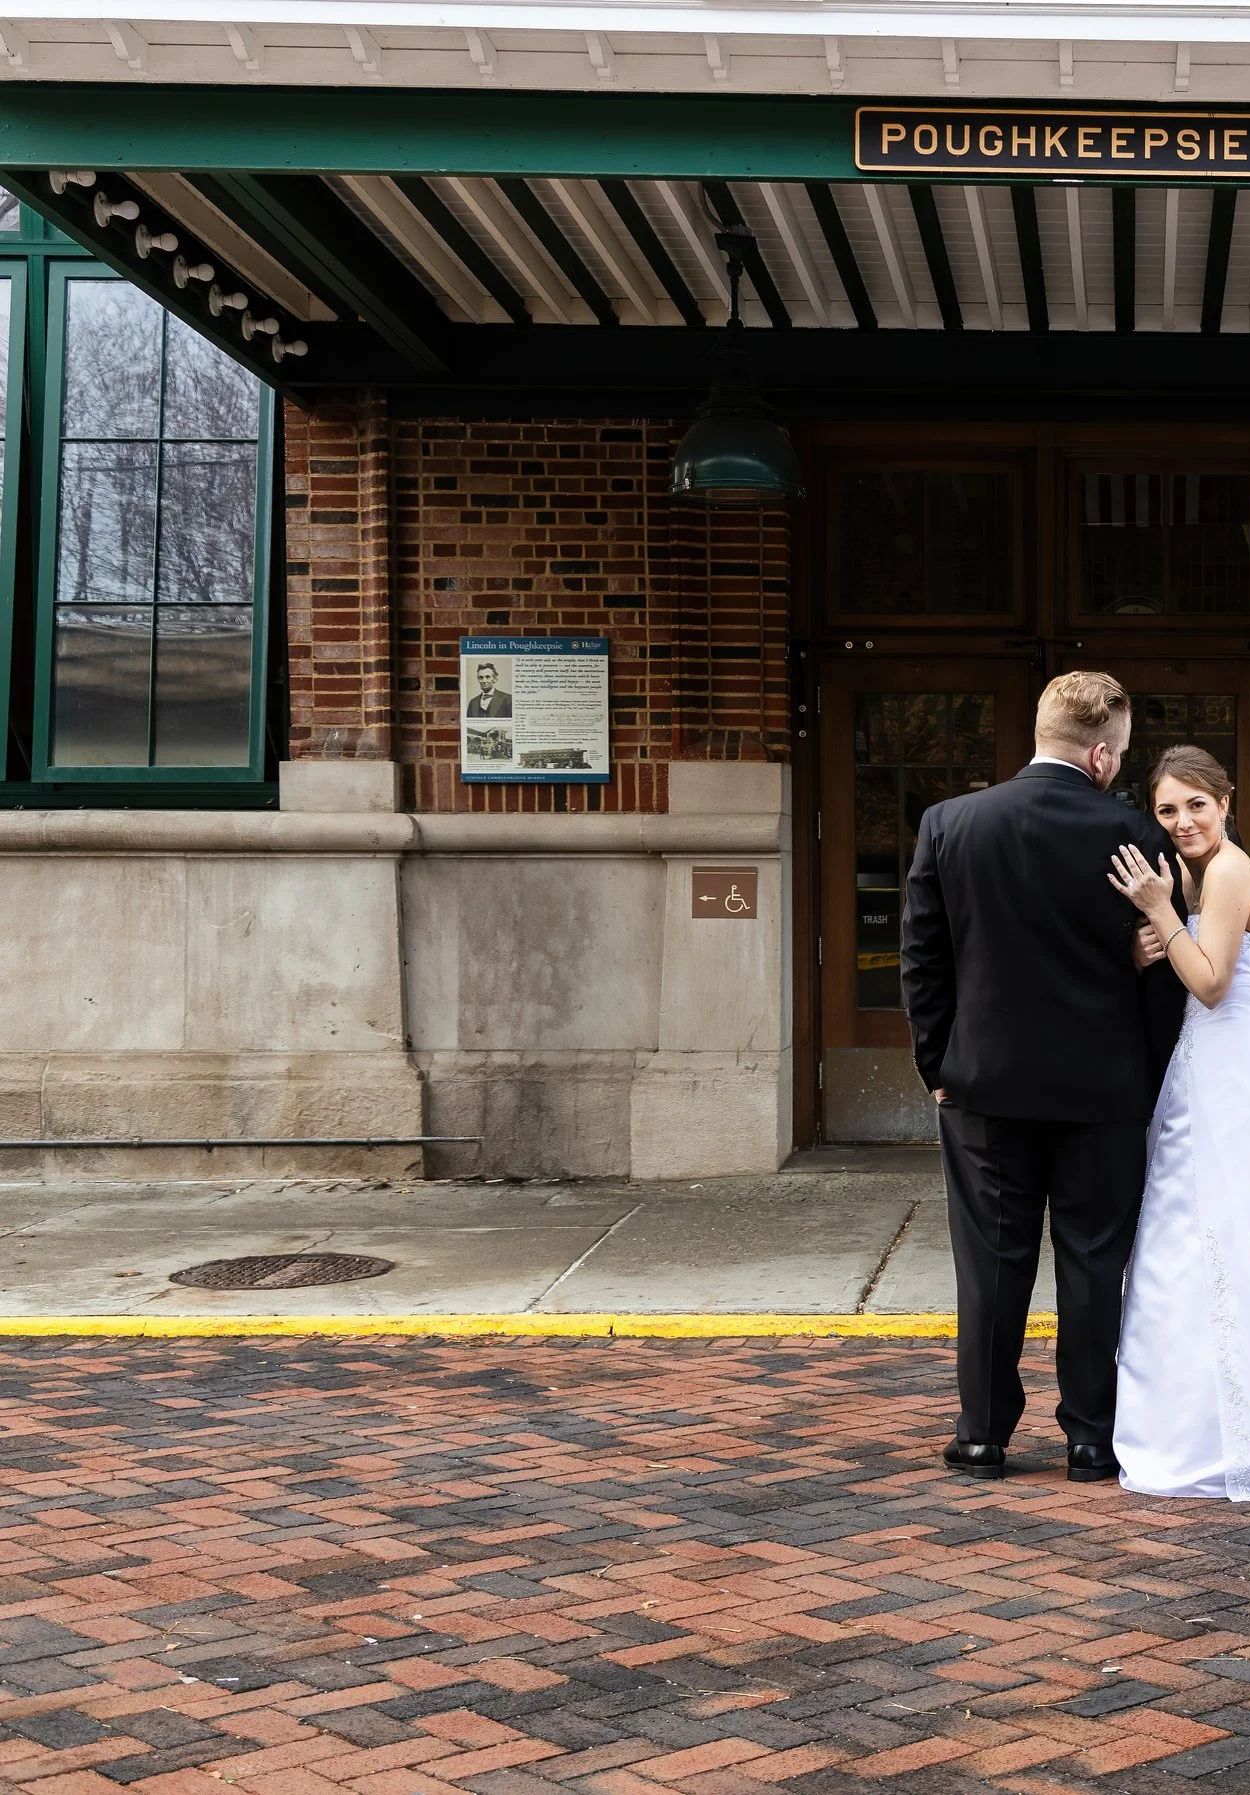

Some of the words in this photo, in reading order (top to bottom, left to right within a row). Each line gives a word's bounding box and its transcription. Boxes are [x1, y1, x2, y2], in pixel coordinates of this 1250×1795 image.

[881, 123, 1248, 161] POUGHKEEPSIE
[466, 641, 496, 649] Lincoln
[498, 641, 507, 649] in
[509, 641, 563, 652] Poughkeepsie
[862, 915, 888, 924] TRASH
